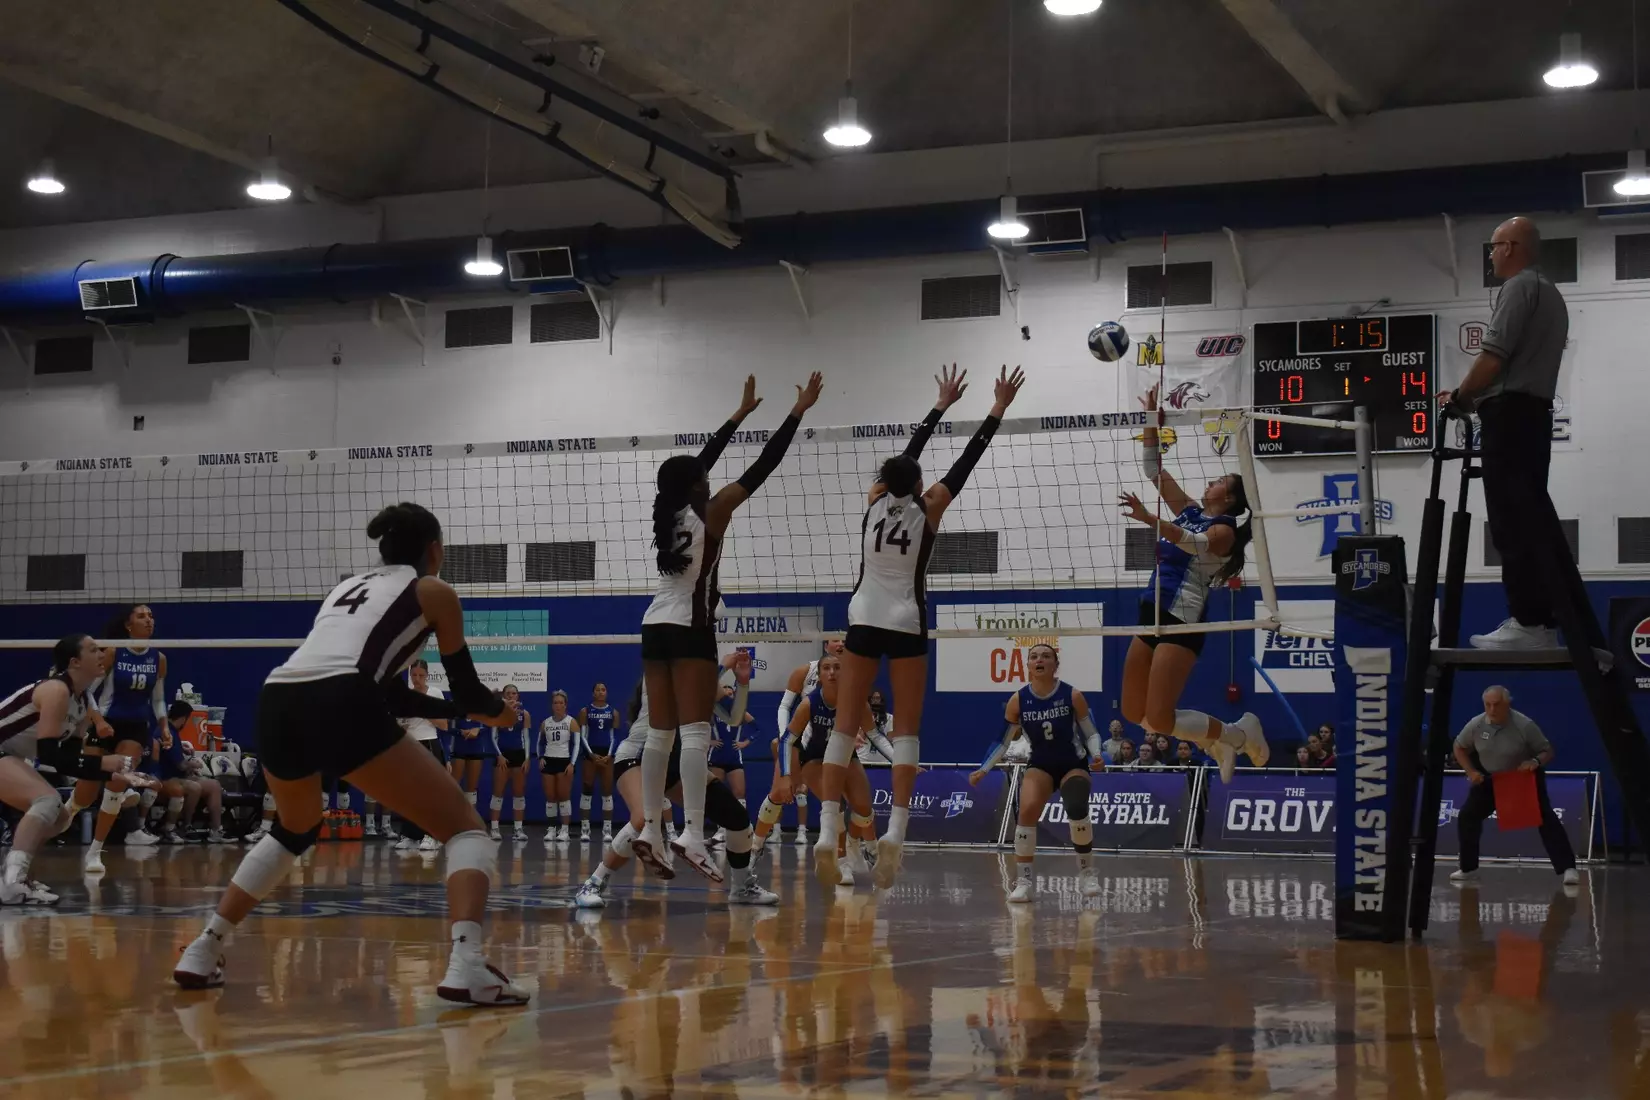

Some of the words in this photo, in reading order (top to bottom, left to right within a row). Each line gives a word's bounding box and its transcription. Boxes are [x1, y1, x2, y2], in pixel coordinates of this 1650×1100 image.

[1331, 320, 1383, 348] 1:15
[1195, 334, 1246, 357] UIC
[1258, 356, 1322, 373] SYCAMORES
[1334, 362, 1351, 372] SET
[1382, 351, 1426, 367] GUEST
[1279, 374, 1304, 403] 10
[1343, 377, 1350, 396] 1
[1400, 371, 1427, 396] 14
[1404, 401, 1428, 410] SETS
[1040, 414, 1097, 430] INDIANA
[1102, 411, 1147, 426] STATE
[1267, 418, 1281, 440] 0
[1412, 411, 1427, 434] 0
[674, 431, 717, 446] INDIA
[729, 430, 769, 444] STATE
[851, 423, 905, 438] INDIANA
[908, 421, 952, 435] STE
[506, 439, 554, 453] INDIANA
[558, 437, 597, 451] STATE
[1258, 442, 1283, 452] WON
[1403, 437, 1429, 447] WON
[198, 453, 241, 466] INDIANA
[243, 451, 278, 464] STATE
[348, 448, 393, 460] INDIANA
[397, 444, 433, 458] STATE
[56, 459, 97, 471] INDIANA
[99, 457, 132, 469] STATE
[873, 517, 912, 555] 14
[1342, 560, 1390, 574] SYCAMORES
[333, 582, 370, 615] 4
[734, 617, 788, 633] ARENA
[976, 612, 1059, 632] tropical
[117, 661, 157, 674] SYCAMORES
[130, 673, 147, 690] 18
[1022, 705, 1070, 722] SYCAMORES
[597, 719, 605, 730] 3
[1041, 720, 1054, 741] 2
[1343, 645, 1391, 802] INDIANA
[551, 731, 561, 742] 16
[872, 788, 935, 810] Diity
[1113, 792, 1152, 804] STATE
[1284, 787, 1306, 797] THE
[1038, 802, 1170, 825] OEYBALL
[1226, 798, 1337, 833] GROV
[1354, 808, 1387, 913] STATE
